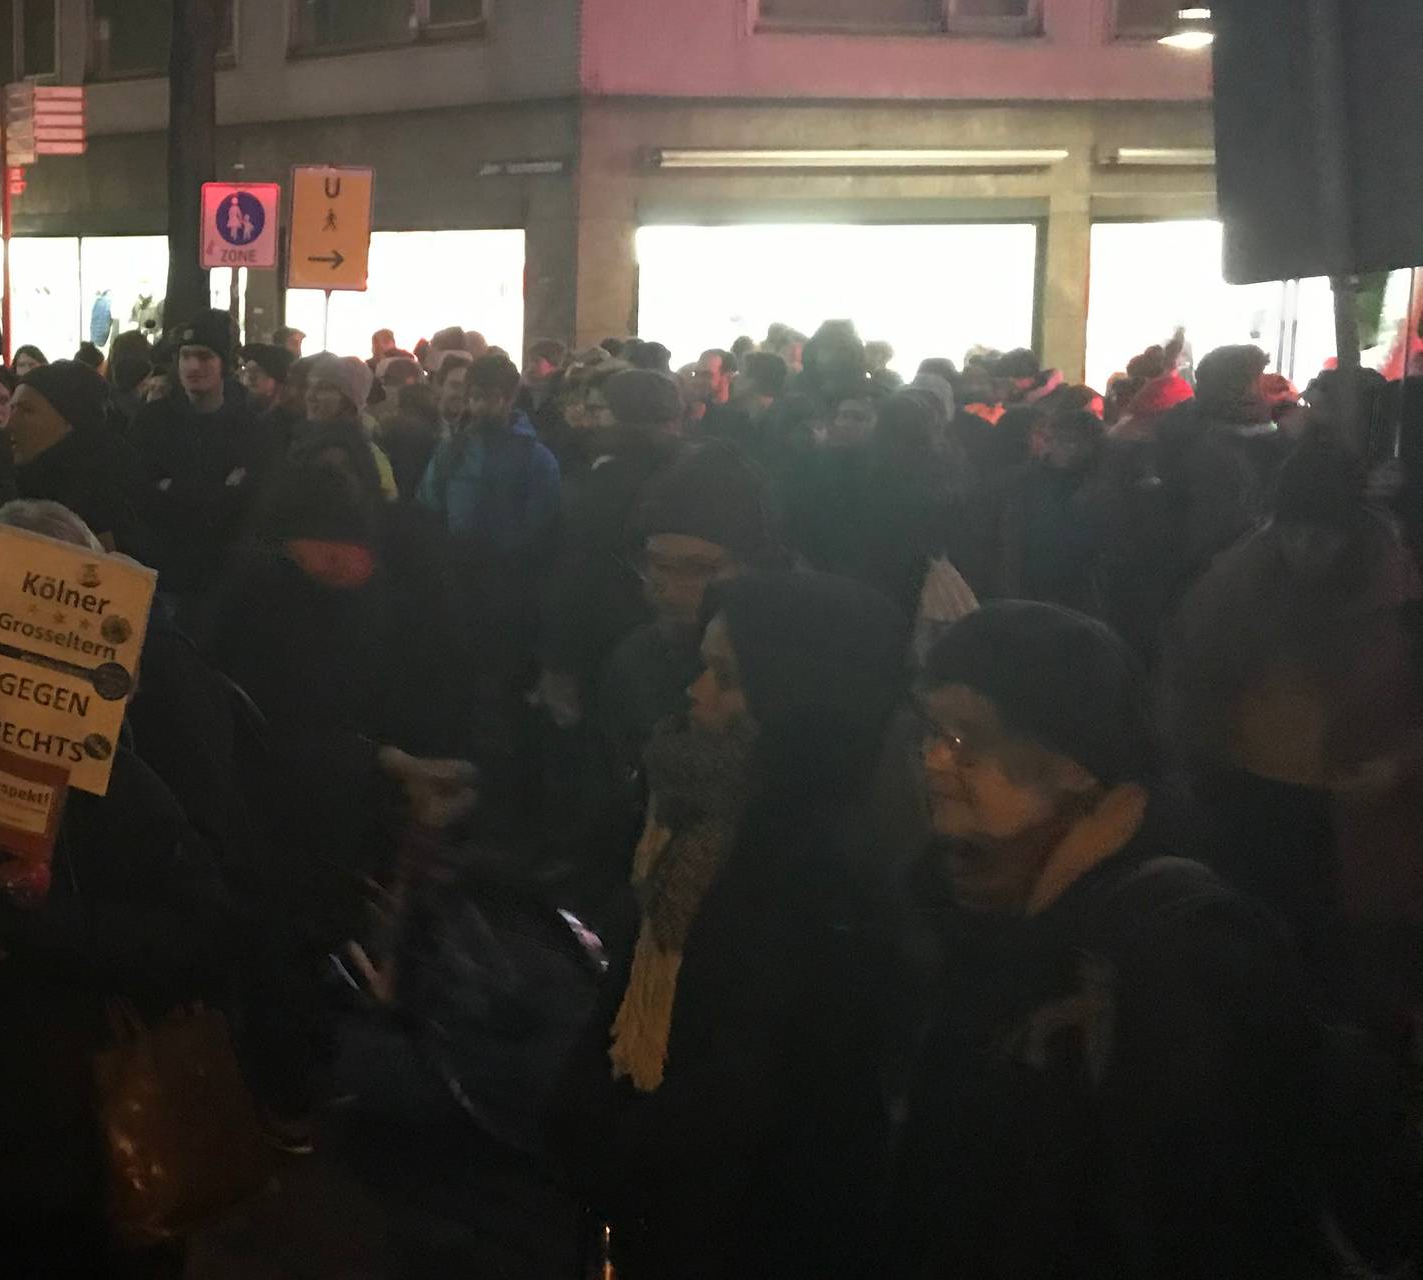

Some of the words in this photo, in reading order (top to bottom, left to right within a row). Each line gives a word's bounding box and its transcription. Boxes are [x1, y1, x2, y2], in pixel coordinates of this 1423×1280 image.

[324, 177, 341, 199] U
[219, 249, 258, 263] ZONE
[22, 571, 111, 615] Kölner
